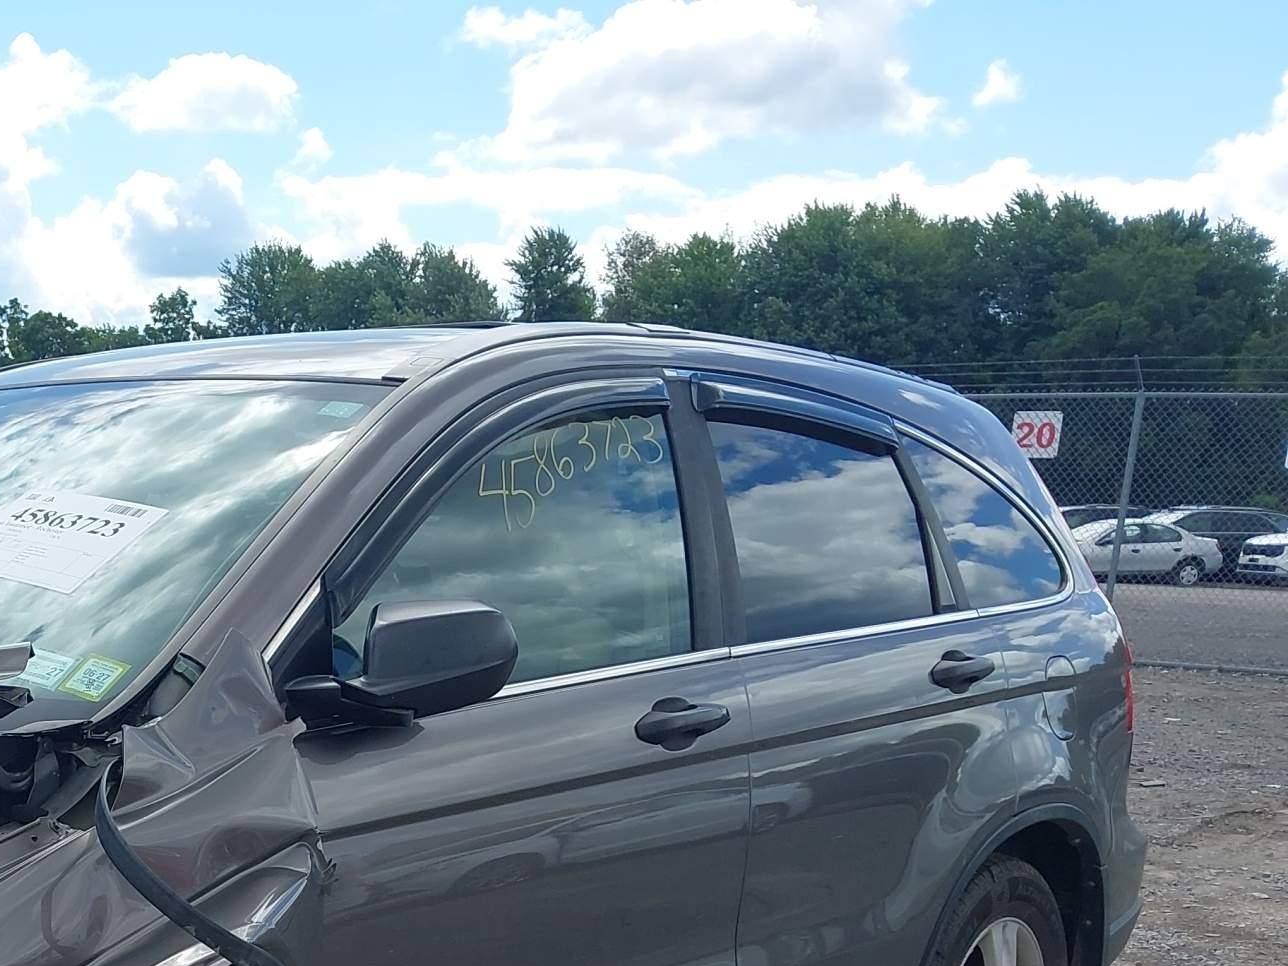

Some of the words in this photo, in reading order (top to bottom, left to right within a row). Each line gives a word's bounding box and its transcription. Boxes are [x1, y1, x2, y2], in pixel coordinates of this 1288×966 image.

[1016, 421, 1056, 449] 20
[479, 415, 663, 532] 45863723
[10, 506, 126, 538] 45863723
